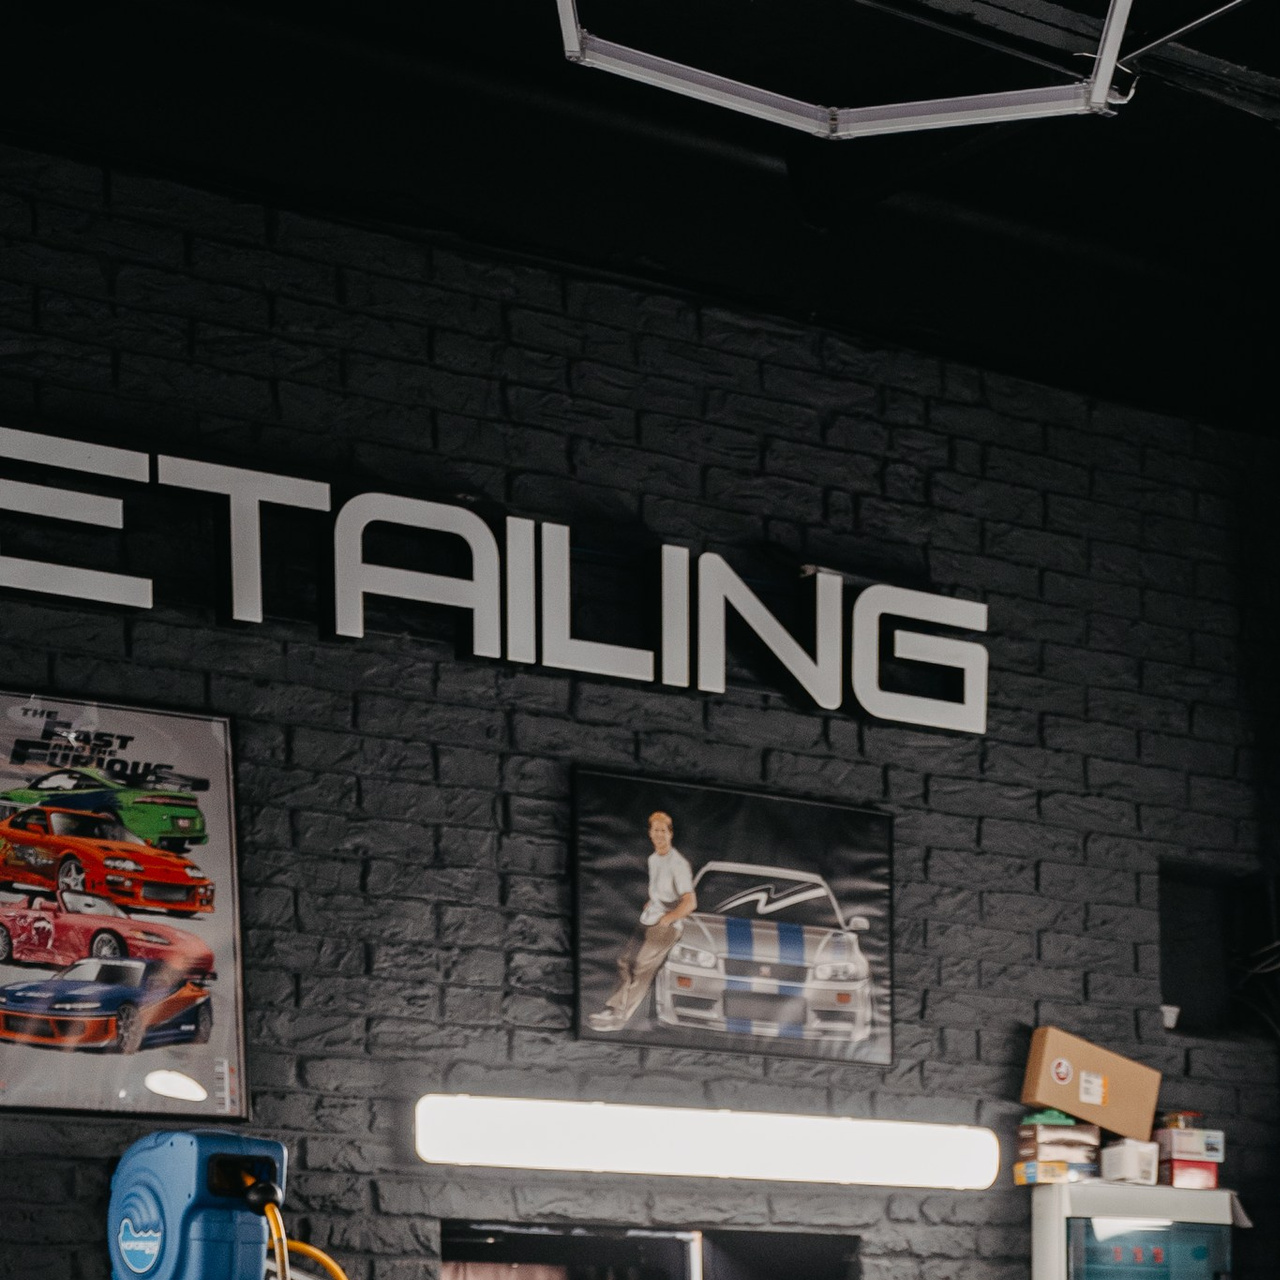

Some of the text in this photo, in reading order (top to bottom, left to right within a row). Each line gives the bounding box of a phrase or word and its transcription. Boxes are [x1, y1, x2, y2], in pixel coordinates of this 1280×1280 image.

[0, 427, 989, 734] ETAILING
[21, 707, 59, 720] THE
[41, 720, 134, 750] FAST
